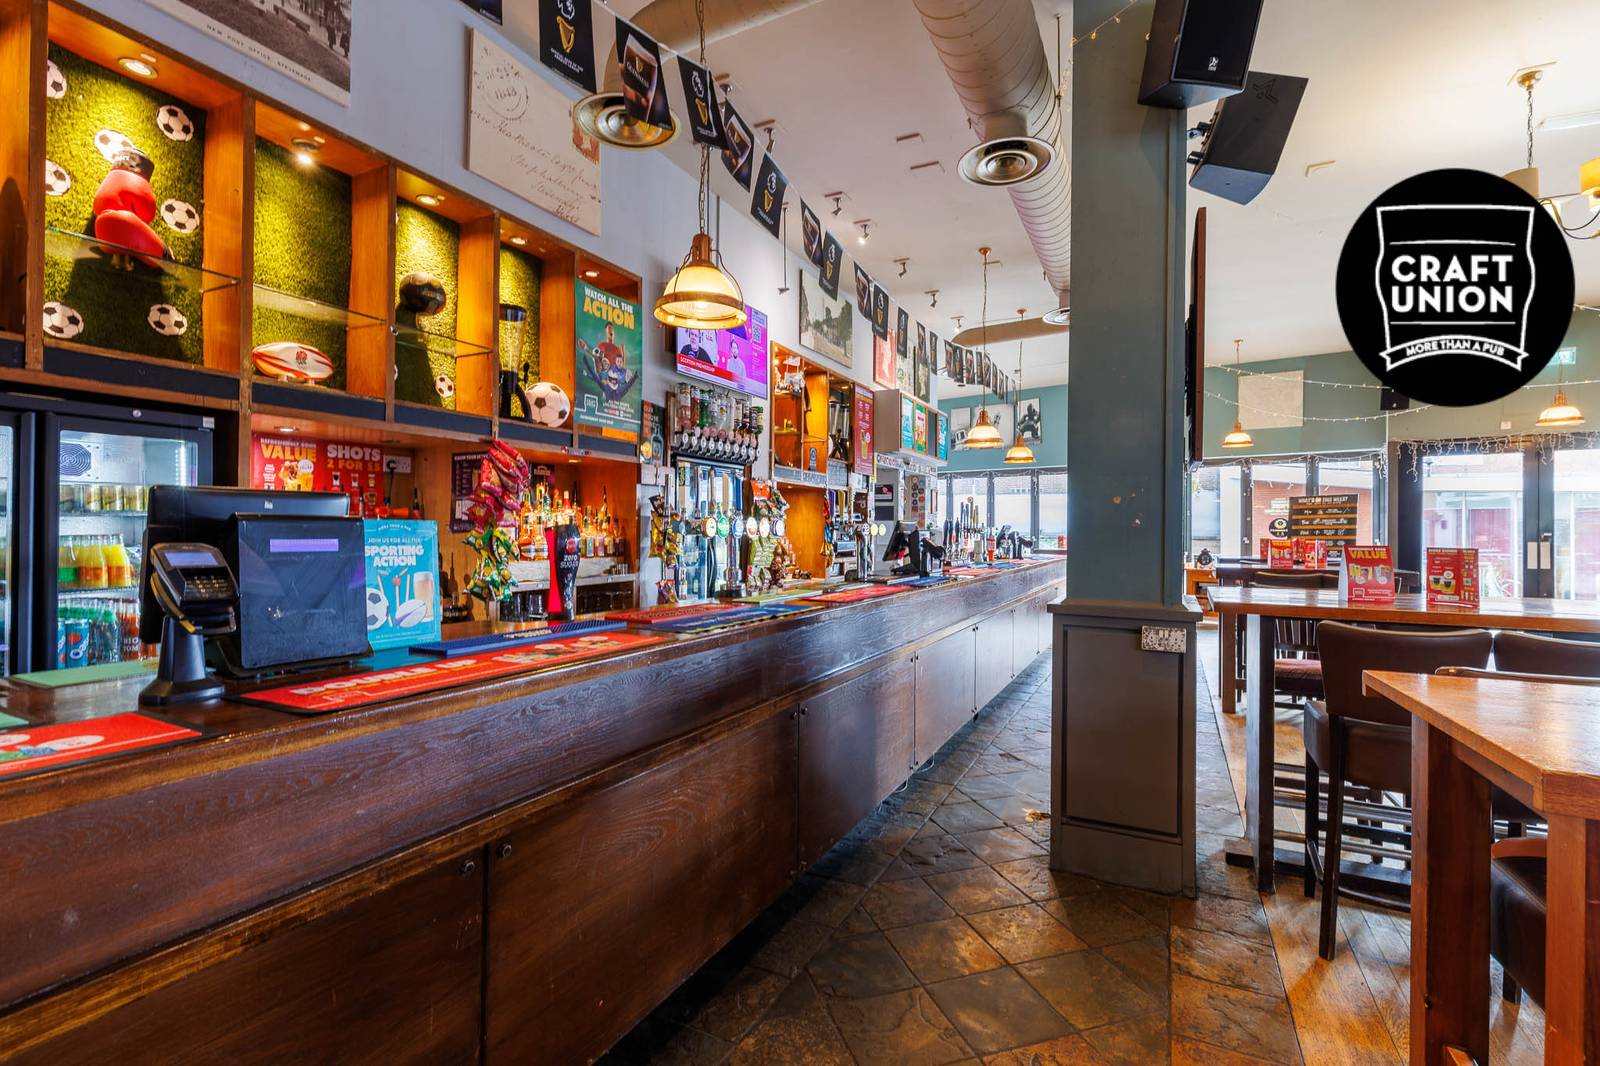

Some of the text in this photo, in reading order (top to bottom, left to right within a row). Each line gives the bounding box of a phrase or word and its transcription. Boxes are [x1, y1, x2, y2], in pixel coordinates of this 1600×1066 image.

[584, 286, 633, 314] WATCH ALL THE
[583, 295, 635, 330] ACTION
[261, 443, 317, 462] VALUE
[327, 443, 381, 461] SHOTS
[327, 459, 335, 469] 2
[338, 459, 363, 471] FOR
[364, 544, 425, 557] SPORTING
[564, 554, 578, 562] zero
[1349, 549, 1387, 560] VALUE
[373, 555, 417, 567] ACTION
[289, 667, 437, 696] DOUBLE
[436, 659, 478, 669] UP
